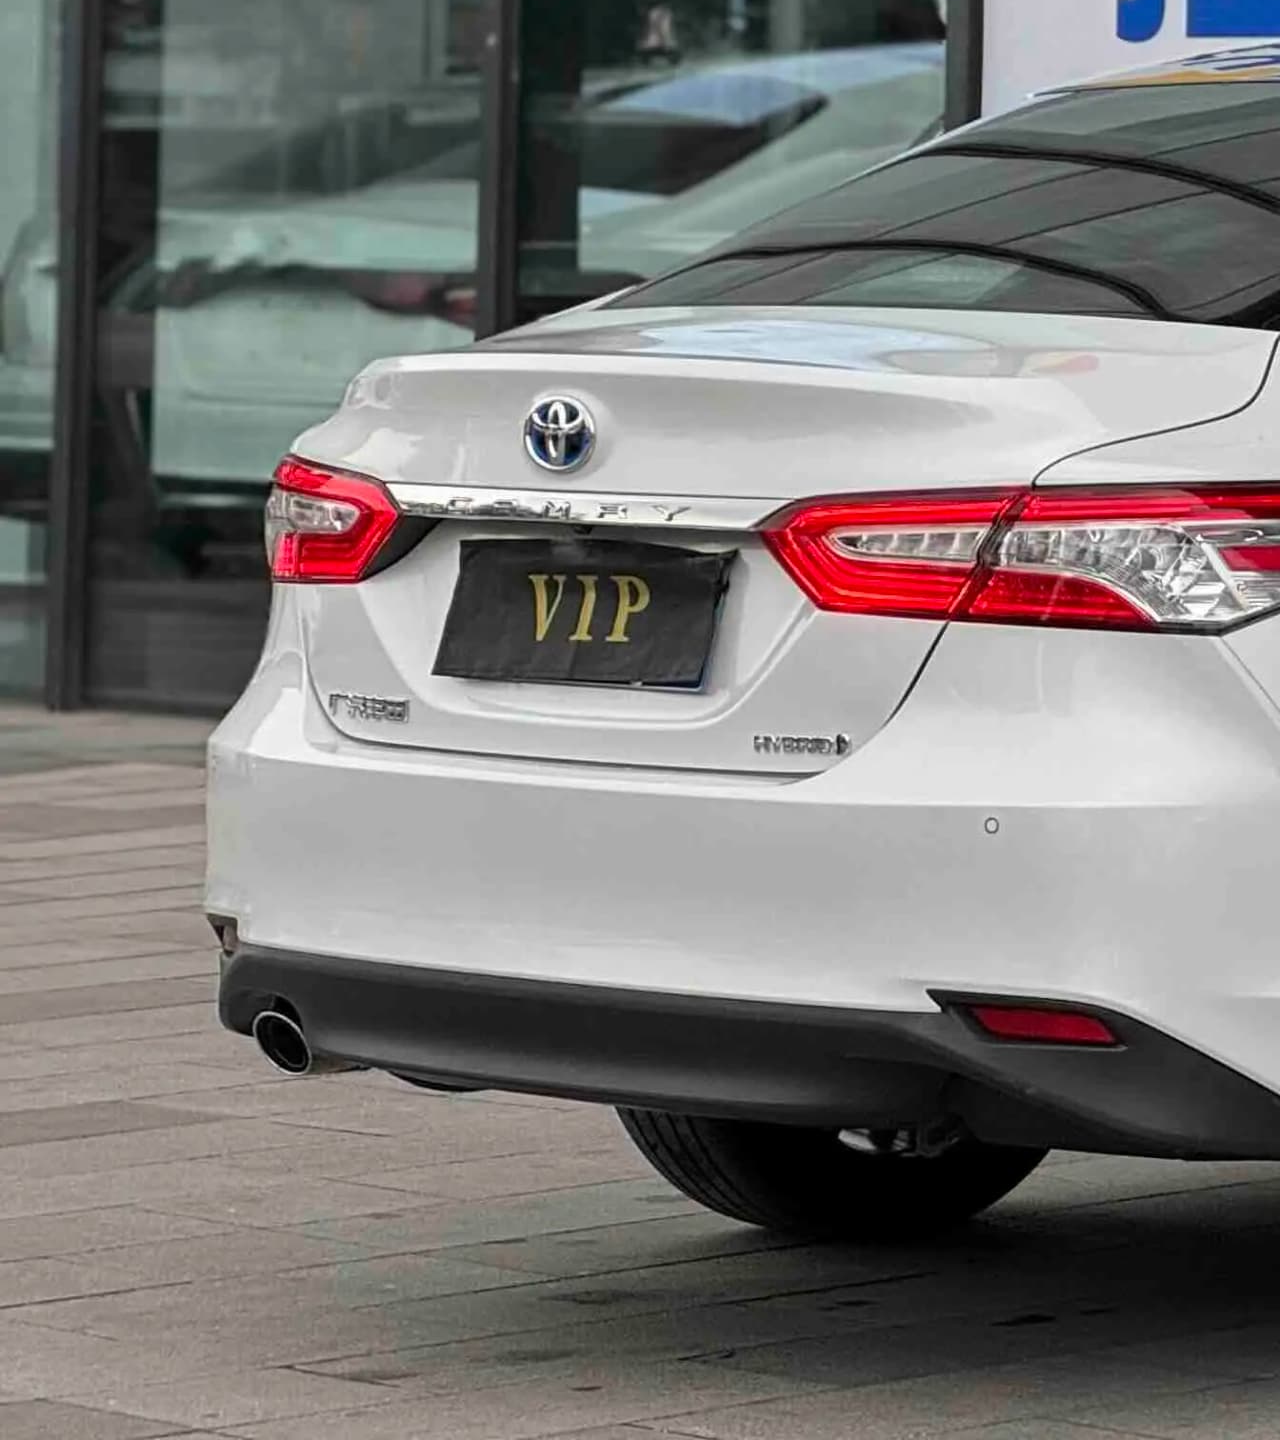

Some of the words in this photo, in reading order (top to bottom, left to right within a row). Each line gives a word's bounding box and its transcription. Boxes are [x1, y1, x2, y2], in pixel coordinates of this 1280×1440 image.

[445, 496, 692, 523] CAMRY
[529, 572, 652, 644] VIP
[753, 734, 835, 755] HYBRID
